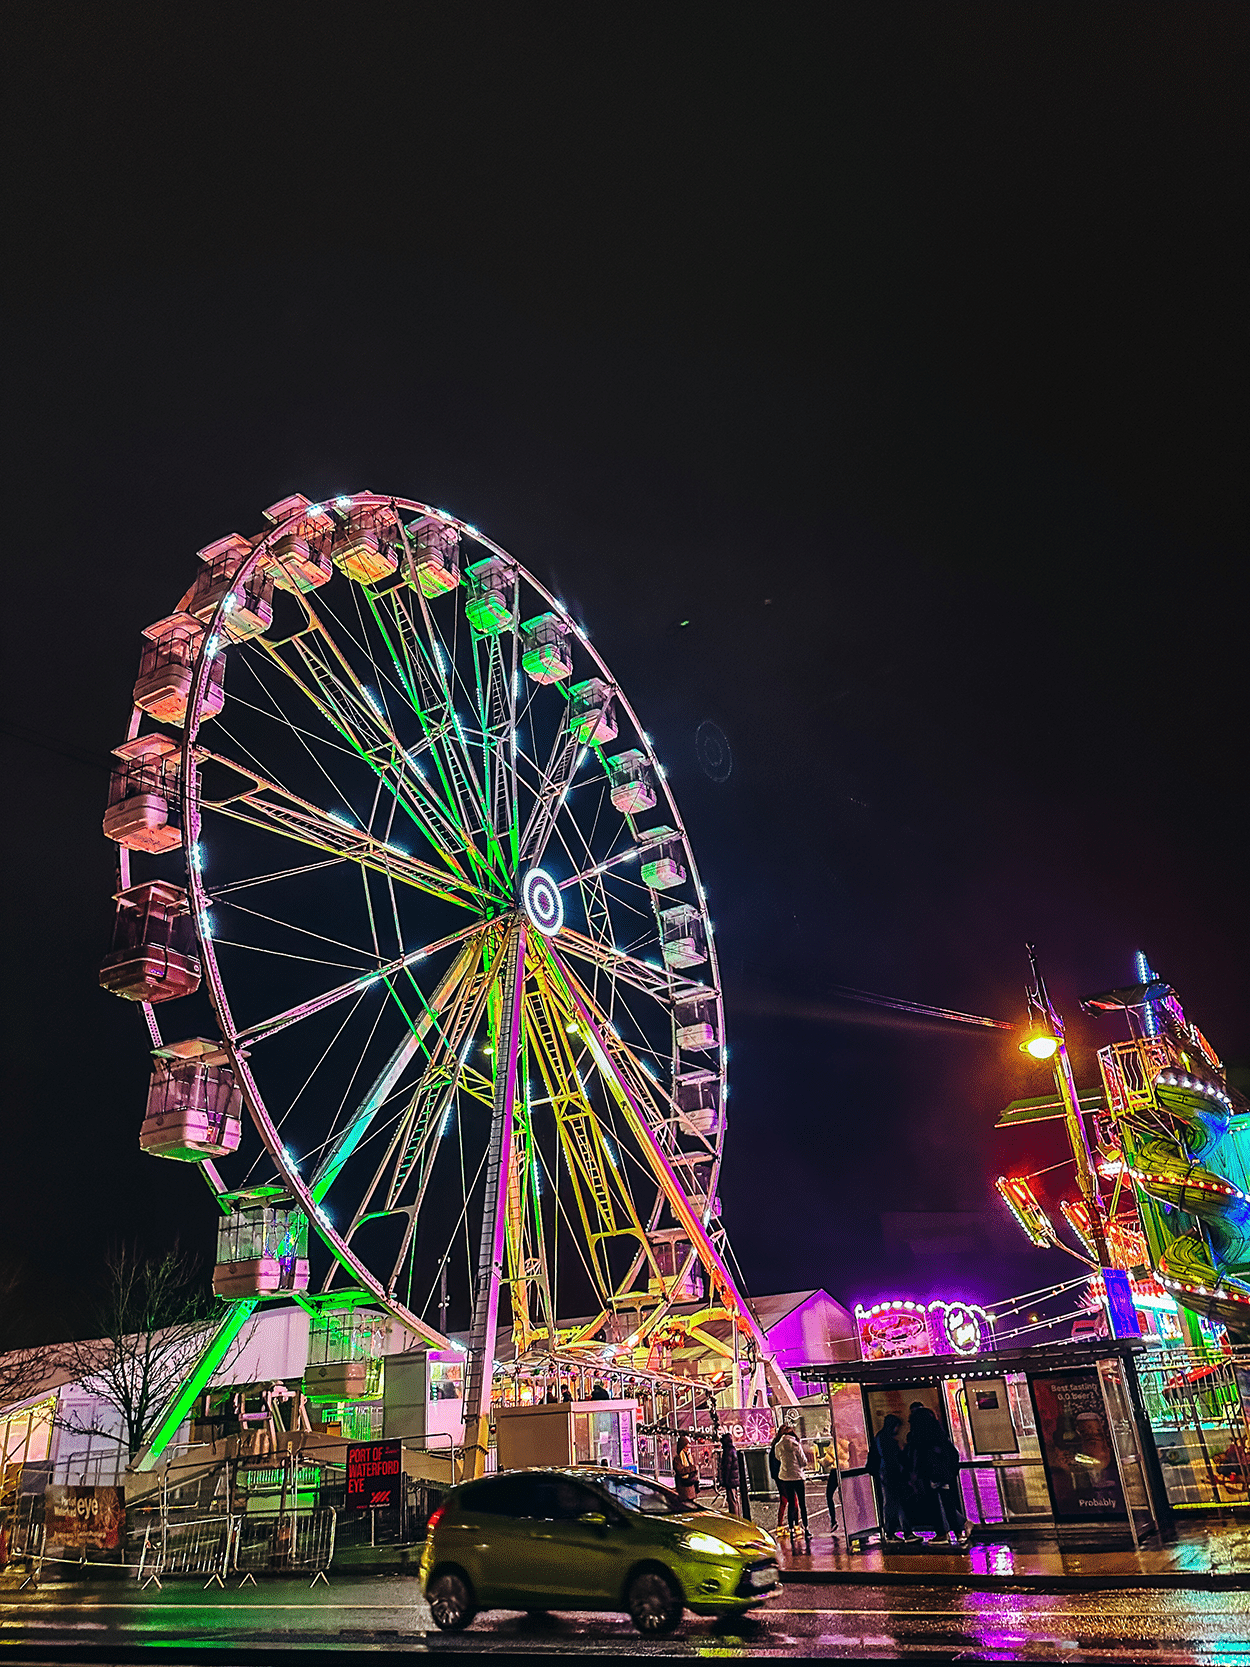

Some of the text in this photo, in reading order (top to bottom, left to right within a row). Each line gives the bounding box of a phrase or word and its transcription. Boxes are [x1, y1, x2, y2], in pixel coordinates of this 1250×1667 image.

[1070, 1383, 1099, 1396] tasting
[349, 1448, 371, 1463] PORT
[373, 1447, 383, 1461] OF
[349, 1460, 399, 1478] WATERFORD
[348, 1478, 365, 1493] EYE
[77, 1498, 99, 1520] eye
[1079, 1498, 1117, 1508] Probably
